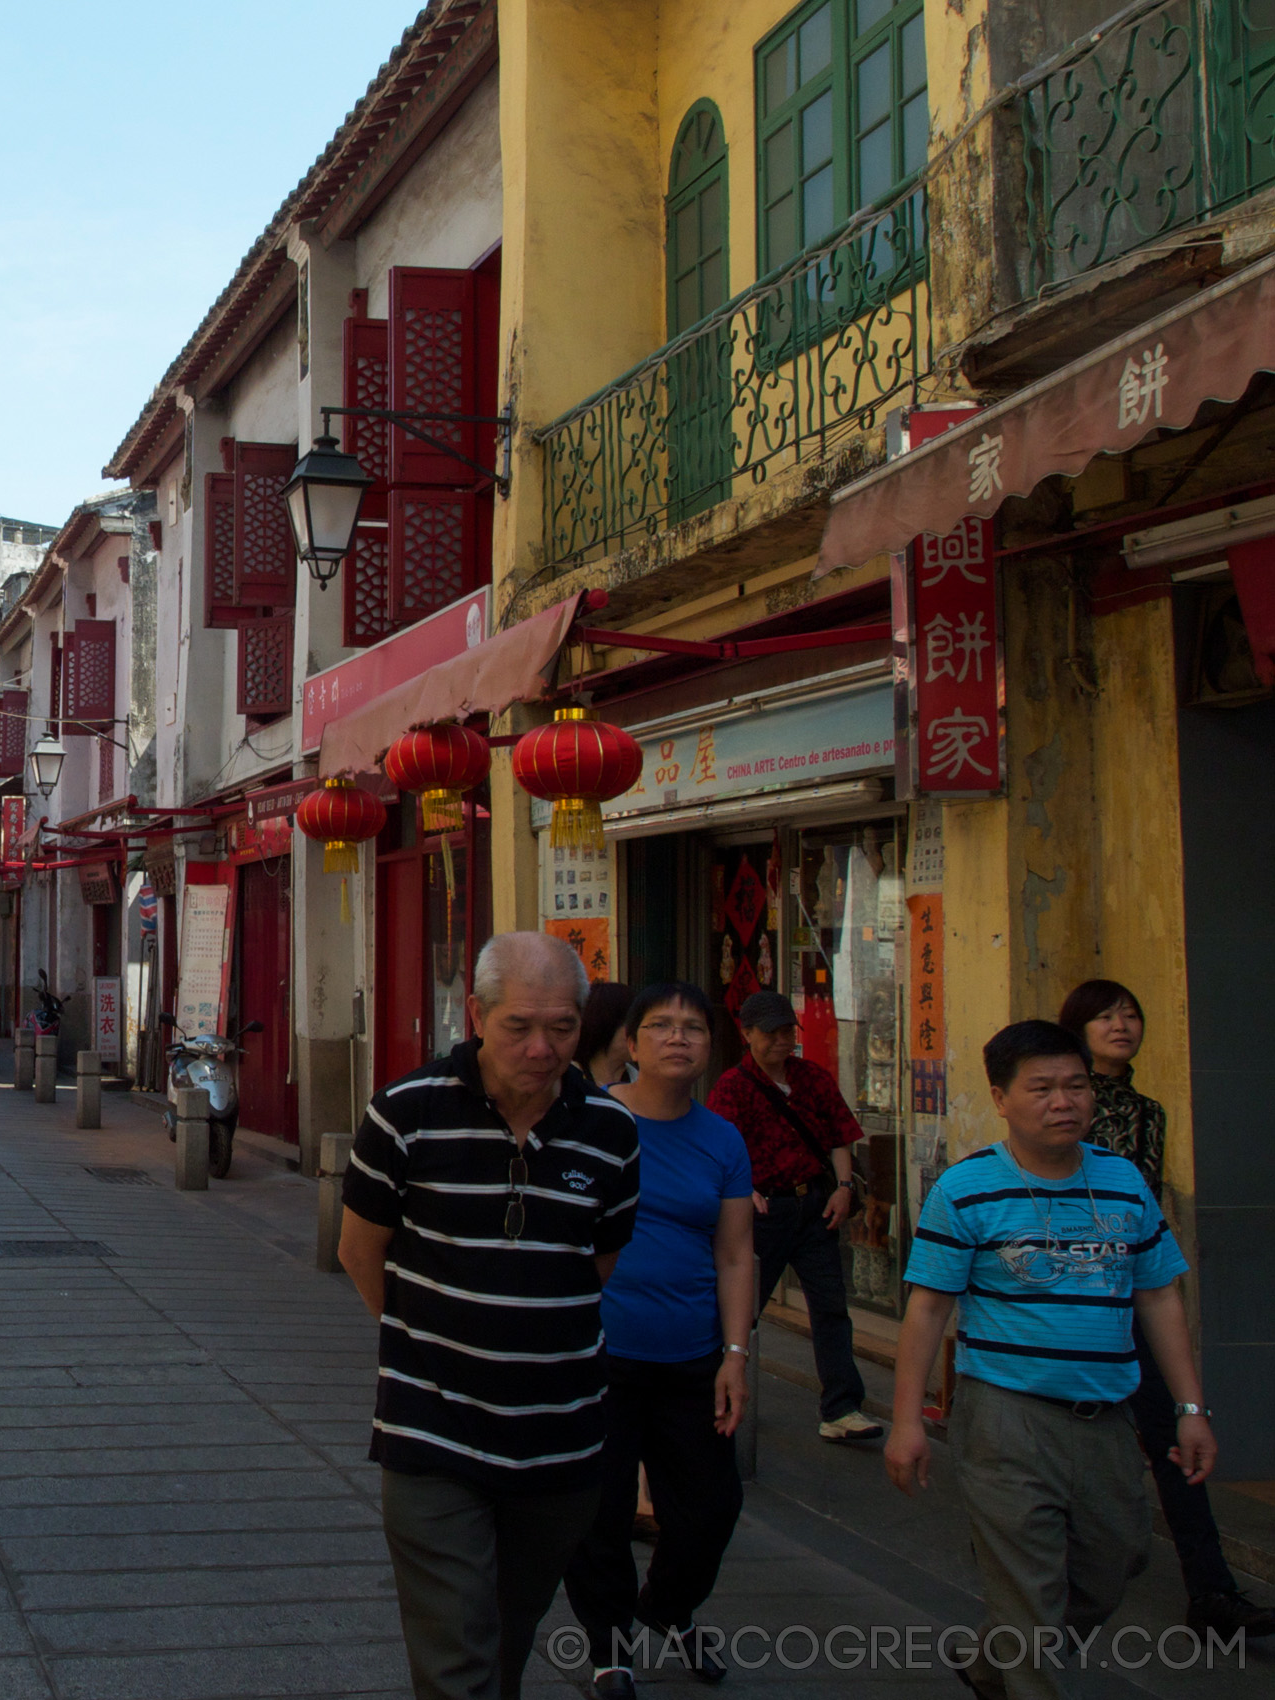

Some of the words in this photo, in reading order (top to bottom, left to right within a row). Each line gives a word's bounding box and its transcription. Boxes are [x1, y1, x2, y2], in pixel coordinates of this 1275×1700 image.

[1118, 343, 1169, 430] 餅
[968, 433, 1004, 503] 家
[727, 762, 752, 780] CHINA
[754, 758, 776, 775] ARTE
[778, 755, 807, 771] Centro
[808, 750, 820, 765] de
[822, 743, 872, 764] artesanato
[874, 742, 881, 753] e
[100, 993, 116, 1035] 洗衣
[1069, 1242, 1128, 1262] STAR
